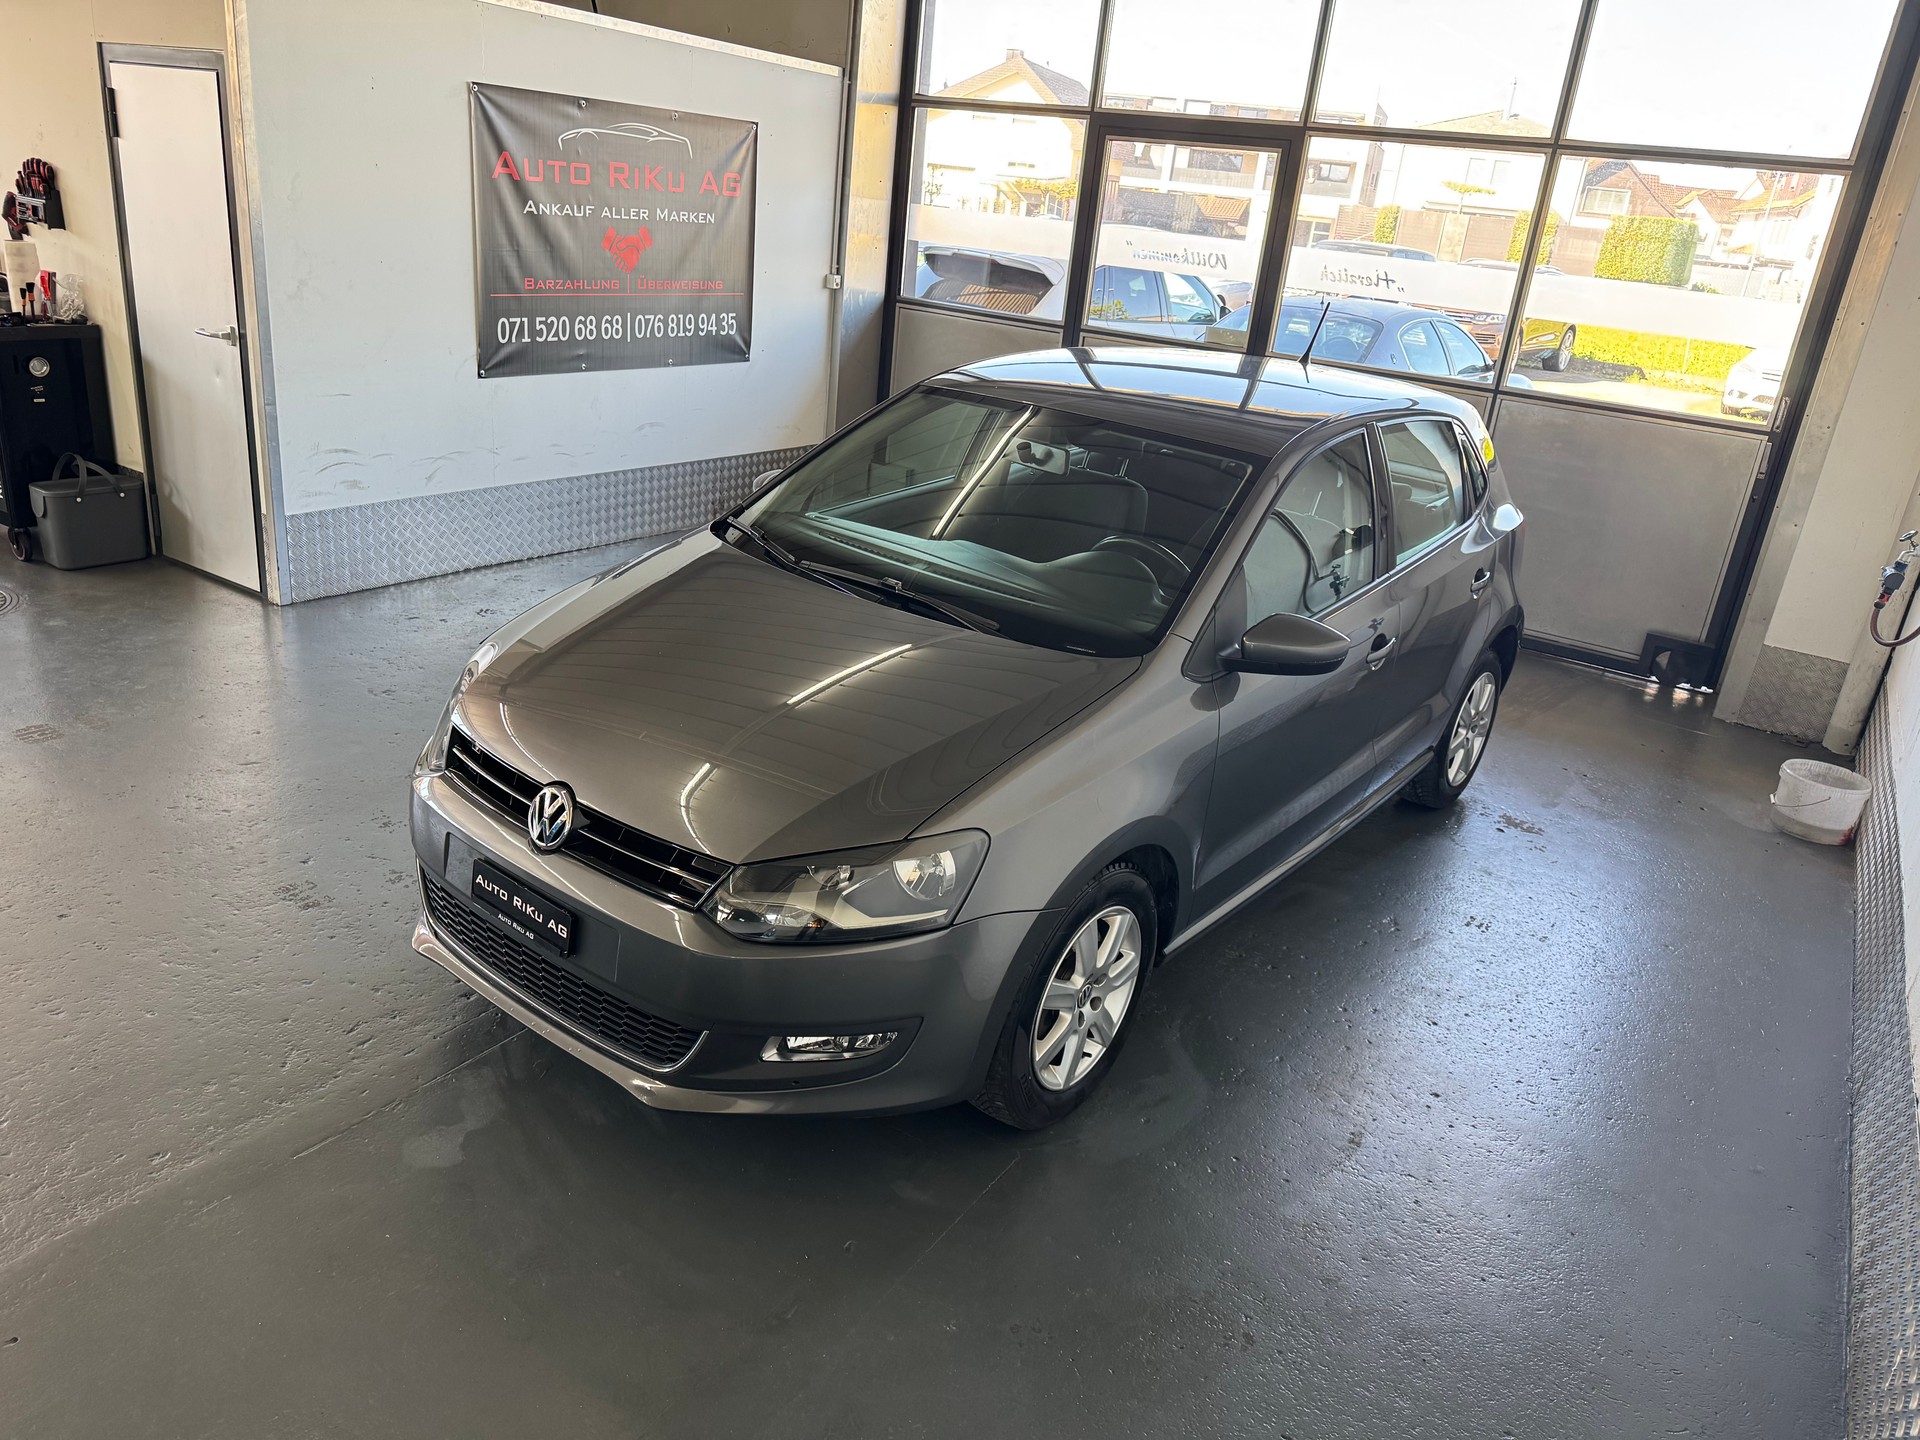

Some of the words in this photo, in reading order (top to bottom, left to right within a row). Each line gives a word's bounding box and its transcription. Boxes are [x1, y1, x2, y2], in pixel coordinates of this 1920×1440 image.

[491, 151, 591, 186] AUTO
[699, 171, 741, 197] AG
[523, 200, 595, 218] ANKAUF
[601, 206, 649, 221] ALLER
[656, 208, 715, 224] MARKEN
[524, 277, 620, 291] BARZAHLUNG
[637, 275, 724, 290] ÜBERWEISUNG
[497, 317, 531, 344] 071
[535, 316, 570, 342] 520
[574, 315, 597, 340] 68
[601, 314, 623, 340] 68
[635, 314, 664, 339] 076
[668, 313, 695, 337] 819
[698, 313, 718, 336] 94
[719, 312, 737, 336] 35
[475, 874, 508, 901] AUTO
[547, 919, 568, 939] AG
[525, 931, 535, 940] AG
